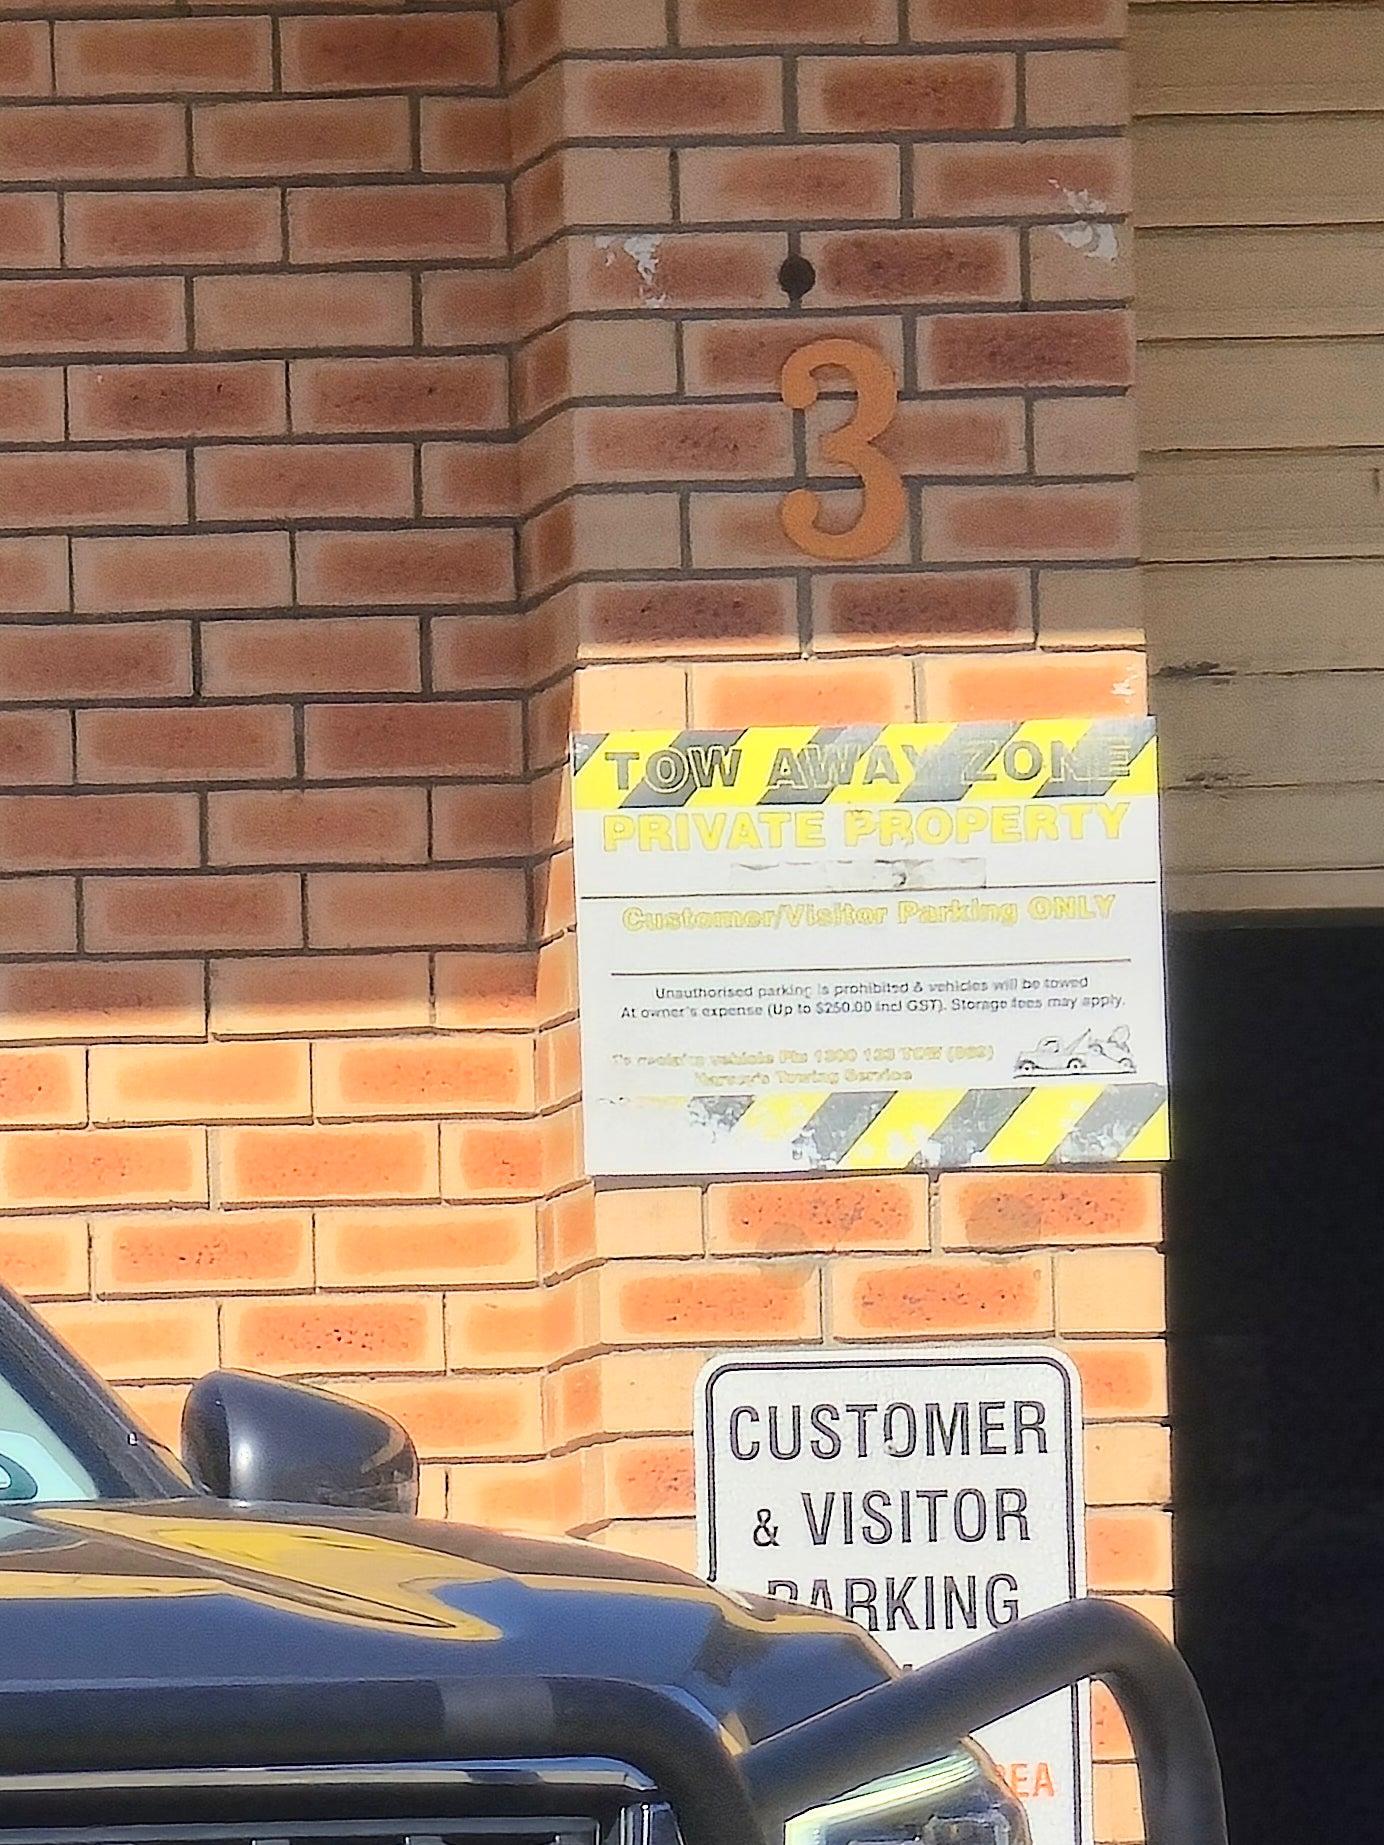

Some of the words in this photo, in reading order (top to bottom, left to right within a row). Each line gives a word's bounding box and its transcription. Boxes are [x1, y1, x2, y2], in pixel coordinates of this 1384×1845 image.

[781, 338, 909, 561] 3
[604, 745, 743, 791] TOW
[767, 743, 944, 790] AWAY
[961, 738, 1131, 786] ZONE
[603, 811, 826, 852] PRIVATE
[843, 801, 1130, 849] PROPERTY
[622, 903, 888, 931] Customer/Visitor
[897, 897, 1019, 925] Parking
[1027, 893, 1115, 920] ONLY
[621, 1006, 636, 1019] At
[641, 1005, 697, 1019] owner's
[702, 1006, 763, 1020] expense
[767, 1003, 793, 1017] (Up
[797, 1003, 811, 1015] to
[951, 998, 1008, 1013] Storage
[1047, 997, 1078, 1011] may
[655, 986, 753, 999] Unauthorised
[758, 985, 812, 999] parking
[817, 983, 829, 996] is
[833, 981, 909, 998] prohibited
[913, 980, 923, 993] &
[929, 979, 989, 993] vehicles
[992, 977, 1018, 991] will
[1022, 978, 1041, 991] be
[1044, 976, 1089, 990] towed
[728, 1400, 1049, 1461] CUSTOMER
[752, 1508, 781, 1548] &
[800, 1487, 1032, 1546] VISITOR
